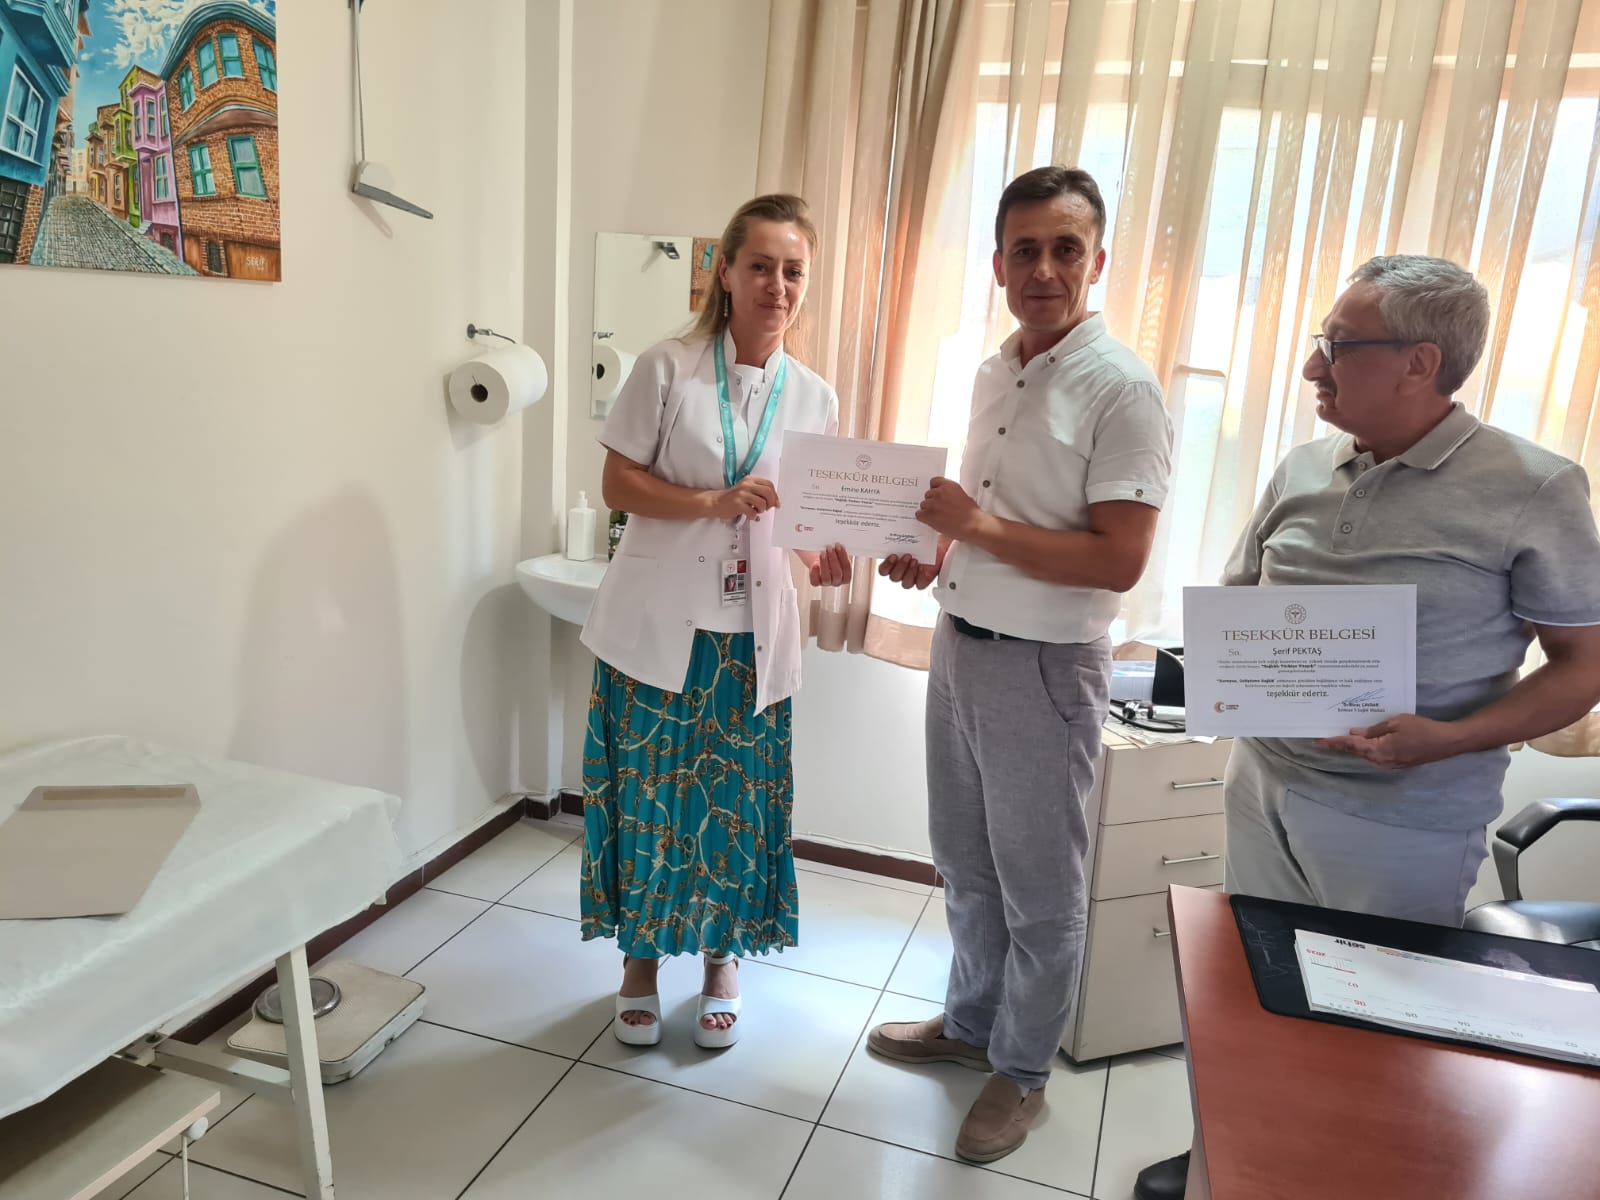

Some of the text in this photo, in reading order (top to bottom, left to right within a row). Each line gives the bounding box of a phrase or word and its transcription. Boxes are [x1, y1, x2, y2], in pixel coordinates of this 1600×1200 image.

[872, 475, 919, 487] BELGESİ
[1221, 626, 1376, 643] TEŞEKKÜR BELGESİ
[1272, 647, 1322, 657] Şerif PEKTAŞ
[1266, 689, 1300, 699] teşekkür
